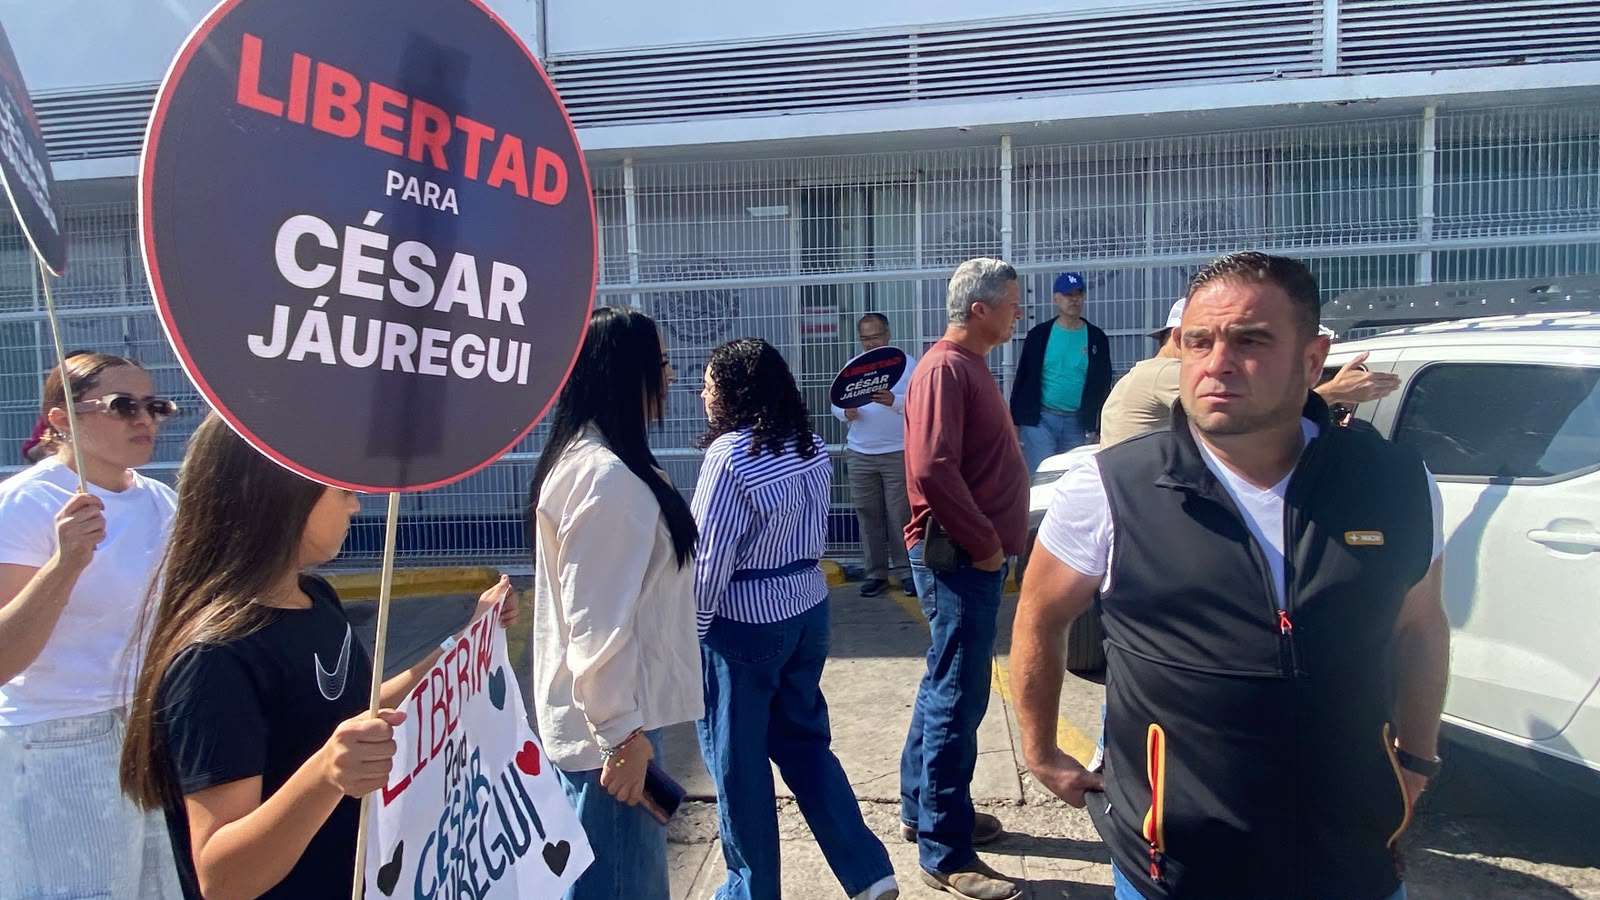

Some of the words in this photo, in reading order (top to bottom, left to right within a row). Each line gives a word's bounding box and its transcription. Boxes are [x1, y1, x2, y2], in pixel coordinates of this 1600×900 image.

[236, 33, 568, 206] LIBERTAD
[385, 169, 459, 215] PARA
[274, 211, 528, 326] CÉSAR
[247, 297, 532, 385] JÁUREGUI
[414, 745, 491, 900] CESAR
